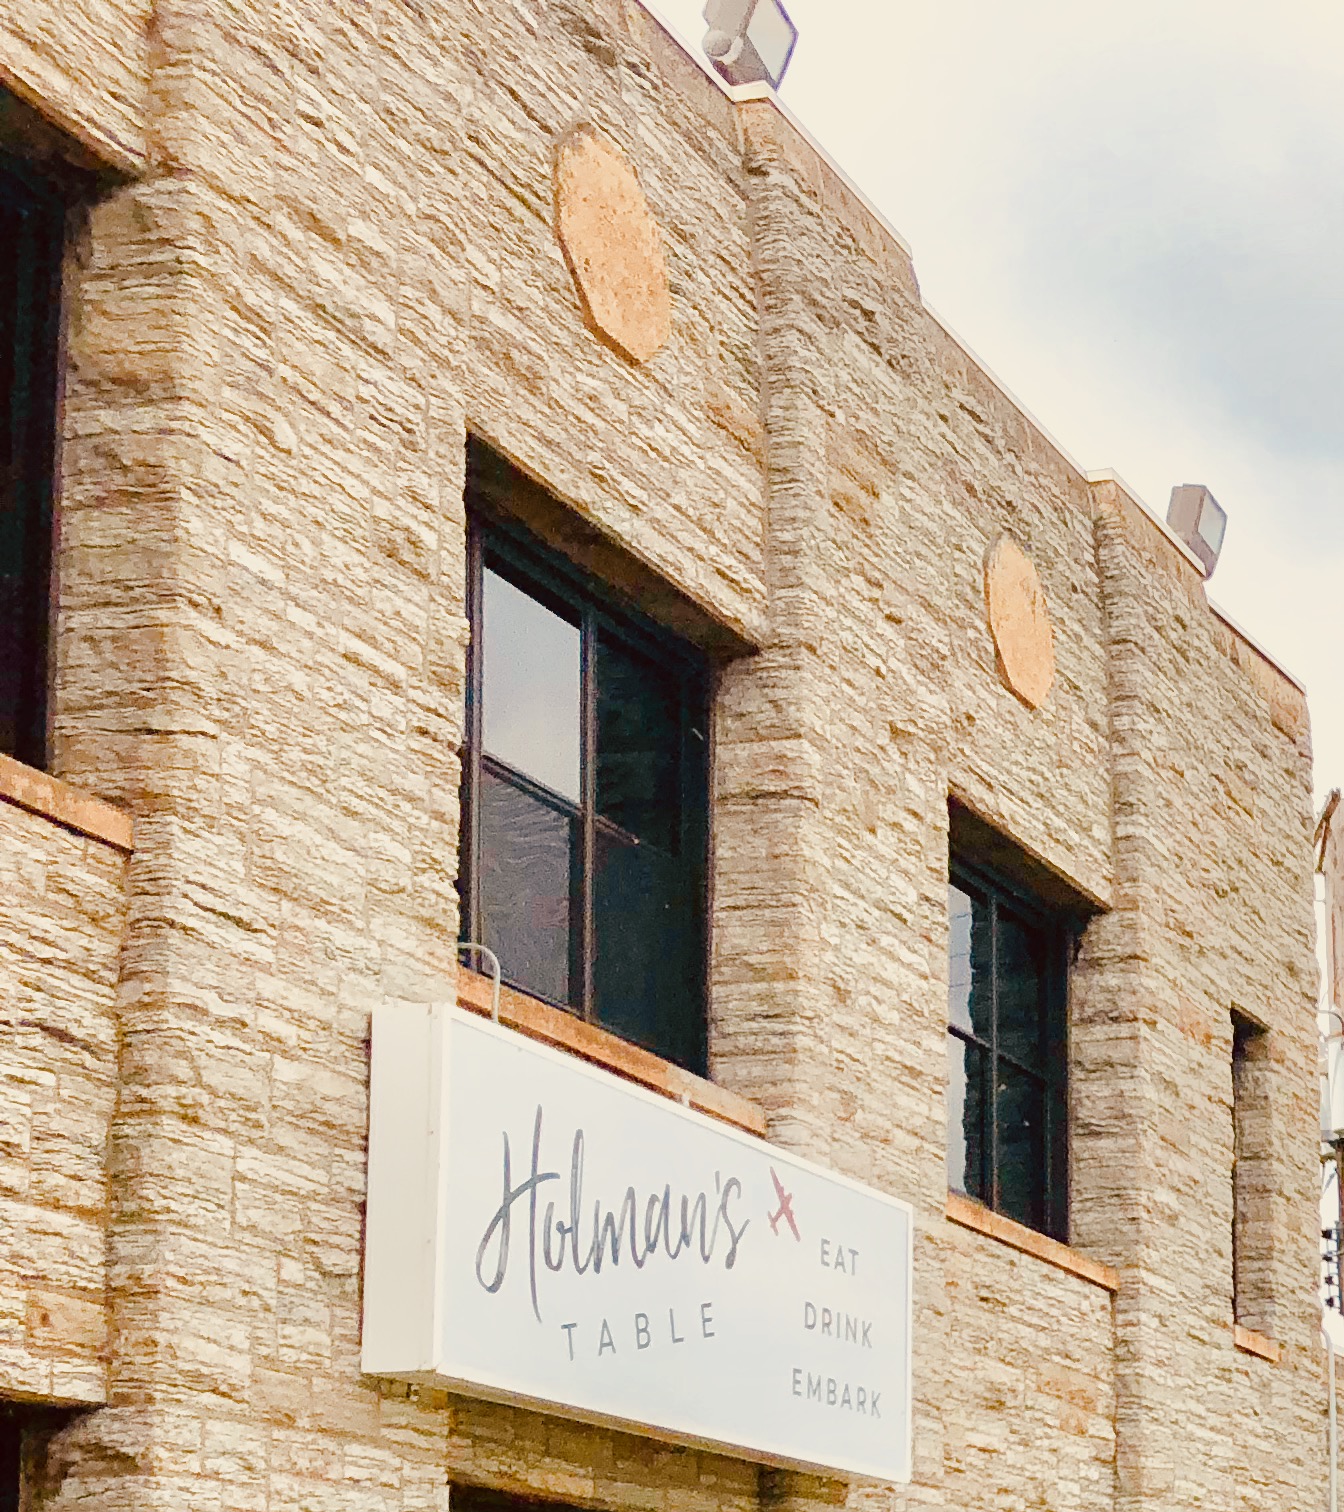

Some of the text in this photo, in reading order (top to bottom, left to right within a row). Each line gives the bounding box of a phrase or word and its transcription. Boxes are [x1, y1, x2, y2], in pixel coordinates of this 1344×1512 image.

[476, 1103, 751, 1324] Holman's
[820, 1238, 860, 1276] EAT
[560, 1301, 716, 1362] TABLE
[804, 1301, 873, 1349] DRINK
[792, 1367, 881, 1419] EMBARK
